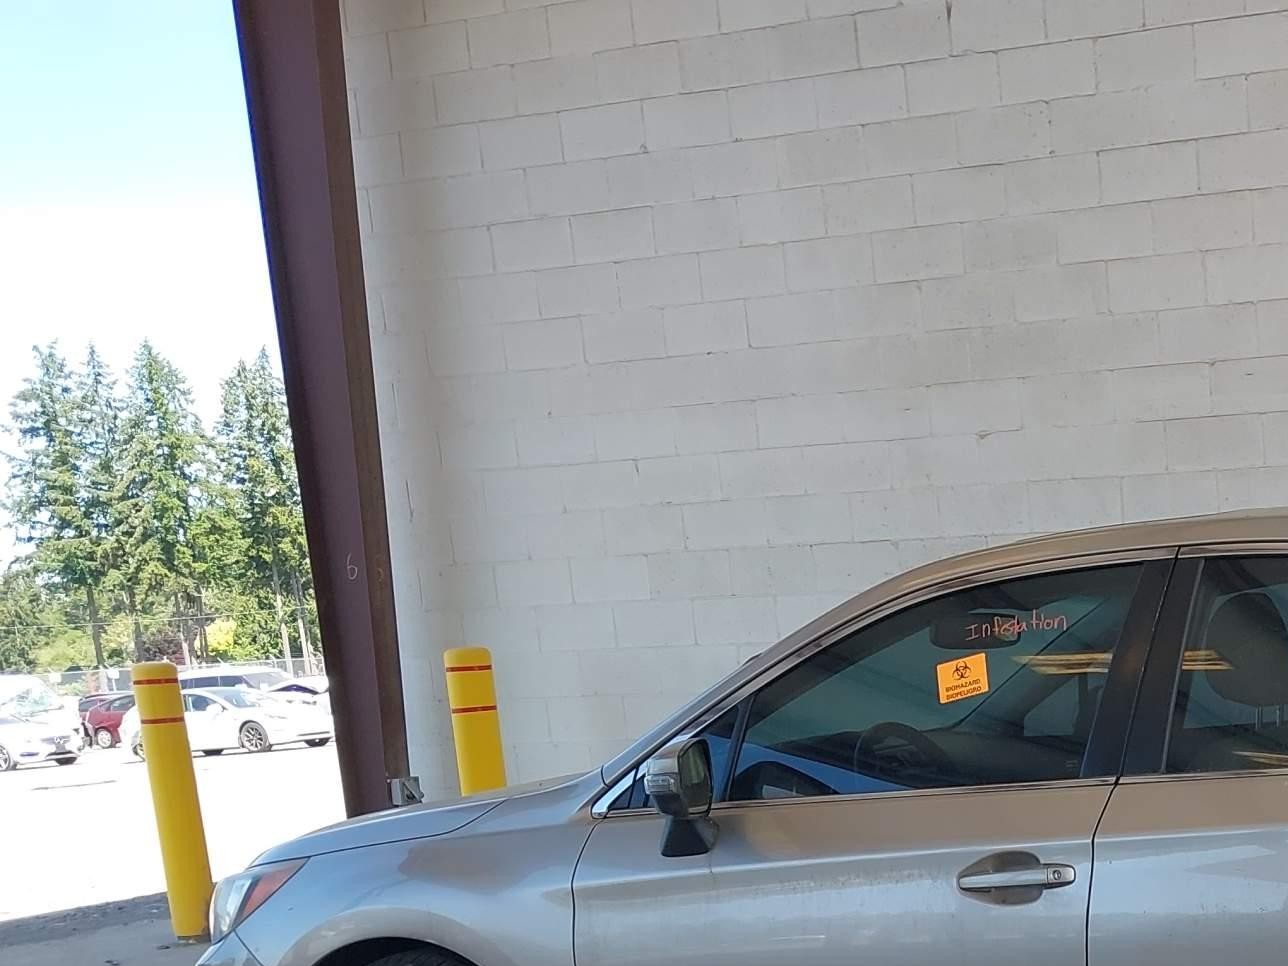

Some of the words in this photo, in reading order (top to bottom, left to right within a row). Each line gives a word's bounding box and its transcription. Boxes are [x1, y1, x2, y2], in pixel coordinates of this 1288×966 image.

[346, 552, 358, 580] 6
[965, 609, 1067, 641] Infestation
[945, 678, 981, 693] BIOHAZARD
[945, 686, 982, 700] BIOPELIGRO
